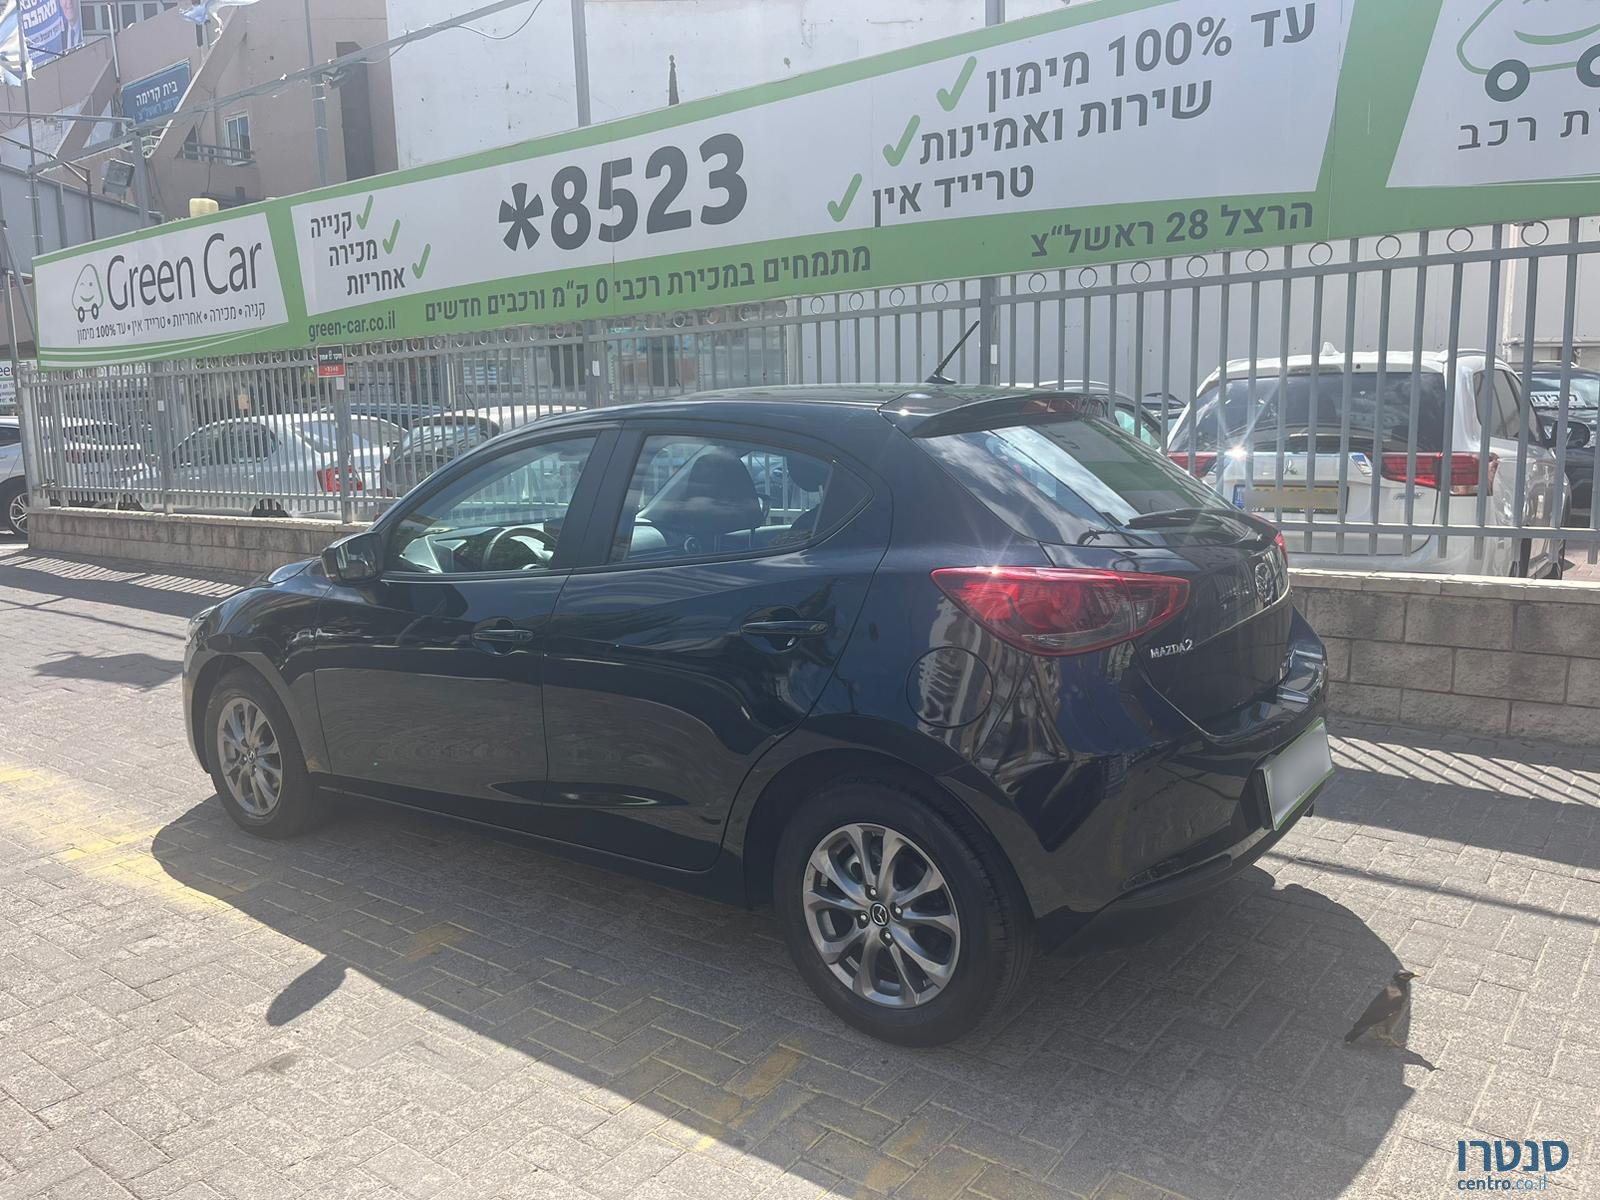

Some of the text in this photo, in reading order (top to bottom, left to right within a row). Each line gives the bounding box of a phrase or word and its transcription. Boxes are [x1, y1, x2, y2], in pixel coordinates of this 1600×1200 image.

[986, 3, 1316, 113] עד 100% מימון
[162, 81, 178, 96] בית
[920, 80, 1213, 165] שירות ואמינות
[1457, 116, 1537, 150] רכב
[872, 165, 1034, 227] טרייד אין
[310, 210, 352, 239] קנייה
[1031, 202, 1313, 258] הרצל 28 ראשל"צ
[329, 239, 378, 267] מכירה
[763, 245, 871, 283] מתמחים
[106, 233, 262, 310] Green Car
[346, 267, 406, 296] אחריות
[667, 262, 755, 295] במכירת
[488, 288, 546, 315] ורכבים
[595, 277, 609, 303] 0
[614, 275, 661, 301] רכבי
[172, 311, 203, 328] אחריות
[209, 306, 237, 322] מכירה
[244, 302, 266, 321] קניה
[425, 297, 482, 322] חדשים
[76, 327, 96, 344] מימון
[96, 324, 117, 338] 100%
[116, 322, 127, 335] עד
[131, 320, 143, 336] אין
[308, 310, 396, 342] green-car.co.il
[1150, 639, 1193, 659] MAZDA2
